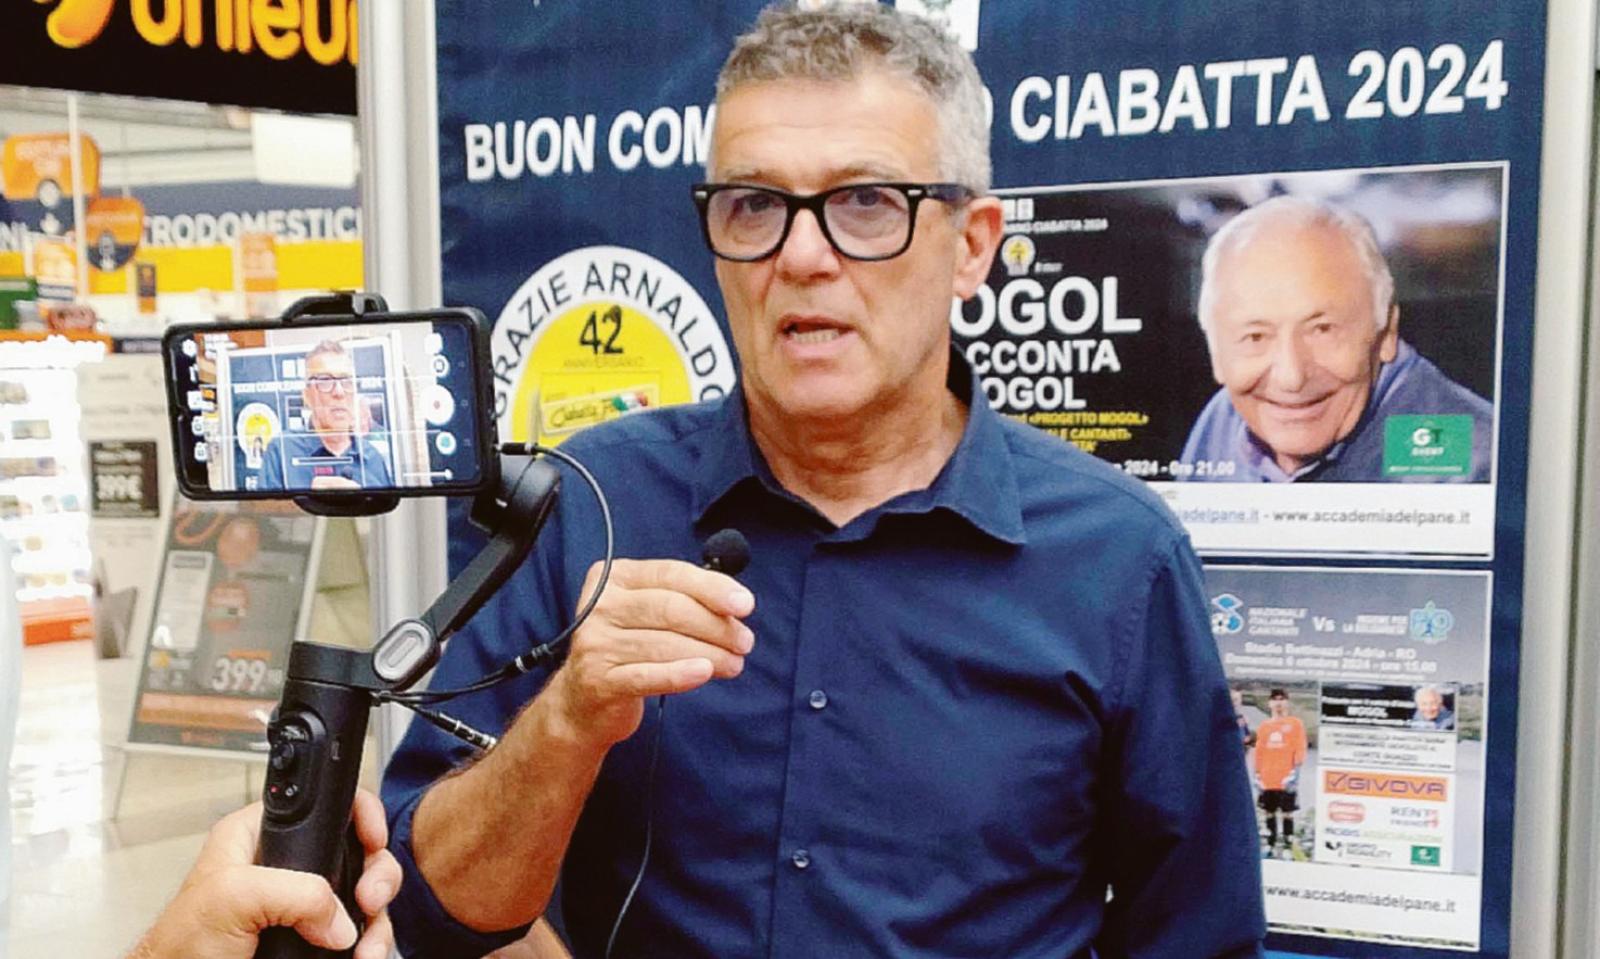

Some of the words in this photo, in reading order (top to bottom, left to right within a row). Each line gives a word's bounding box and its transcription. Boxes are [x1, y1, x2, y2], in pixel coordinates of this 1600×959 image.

[1010, 54, 1330, 141] CIABATTA
[1345, 40, 1507, 119] 2024
[465, 114, 596, 182] BUON
[608, 104, 716, 170] COM
[950, 276, 1142, 337] OGOL
[579, 304, 624, 355] 42
[966, 339, 1121, 375] CCONTA
[982, 376, 1087, 410] OGOL
[1273, 510, 1471, 526] www.accademiadelpane.it
[1312, 616, 1336, 632] Vs
[1347, 776, 1446, 796] GIVOVA
[1265, 885, 1457, 913] www.accademiadelpane.it
